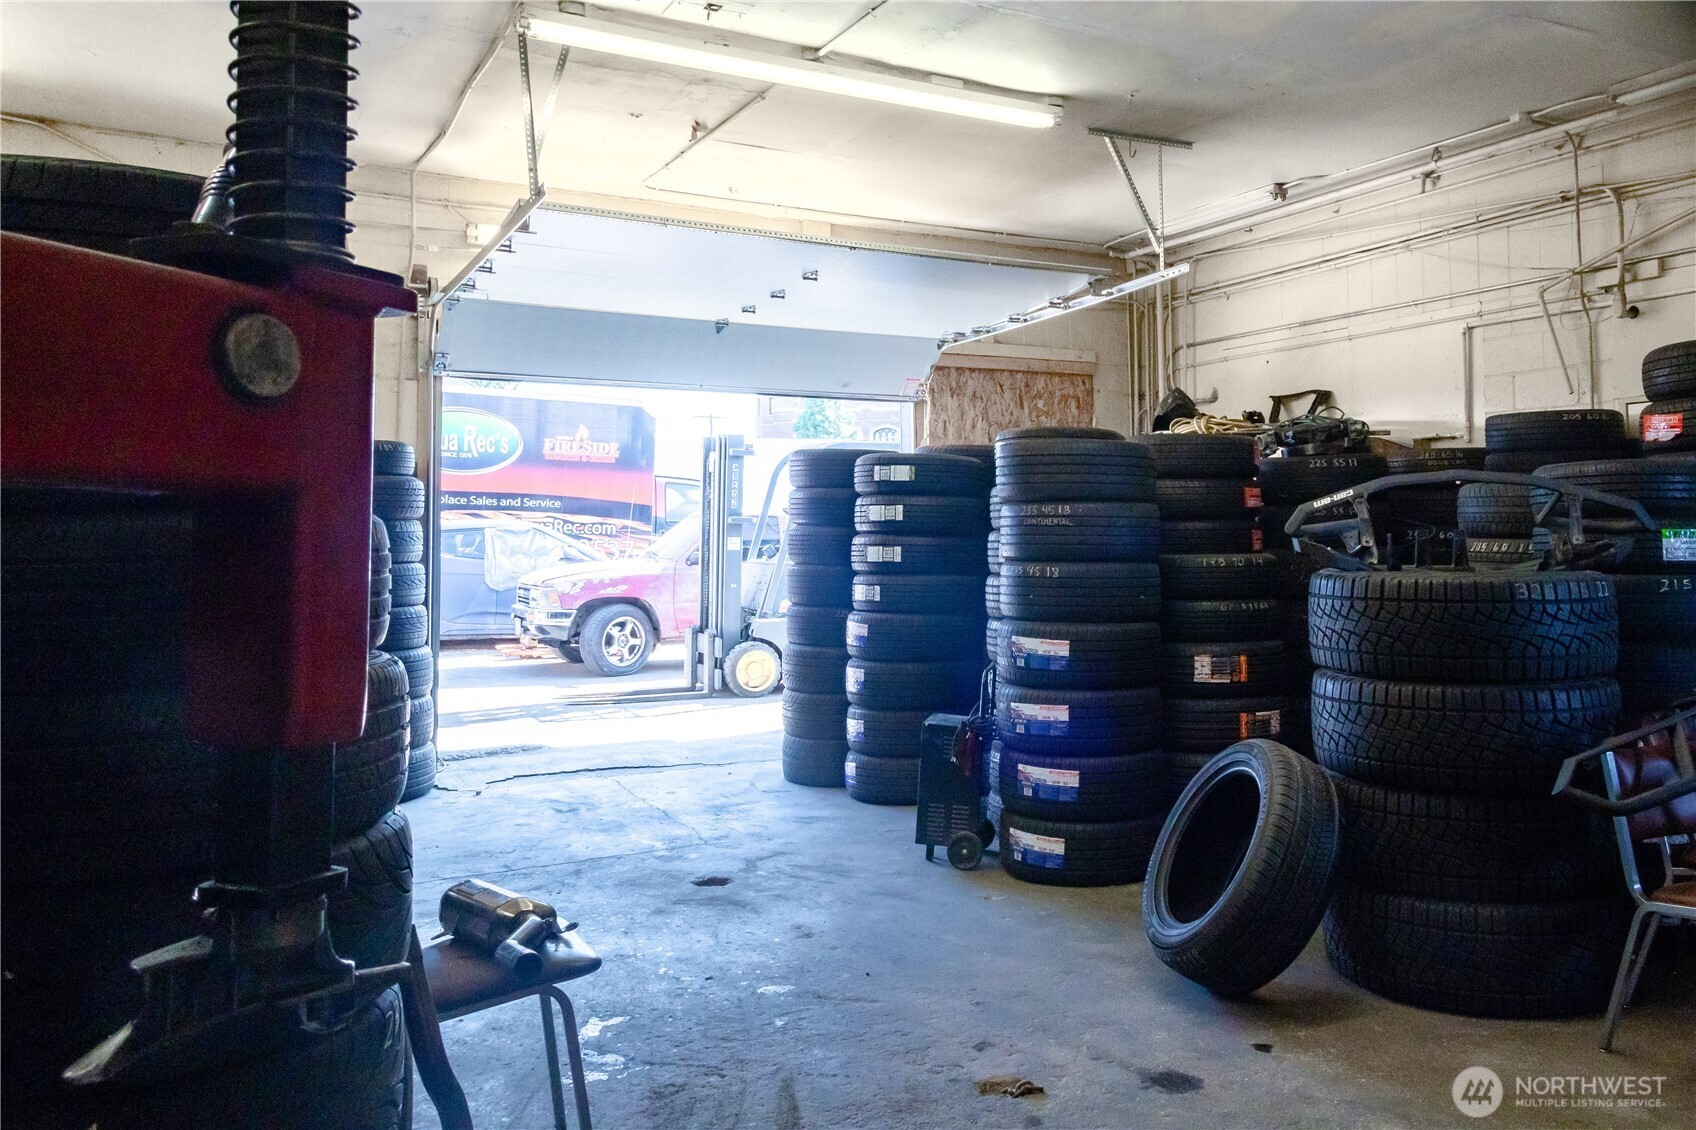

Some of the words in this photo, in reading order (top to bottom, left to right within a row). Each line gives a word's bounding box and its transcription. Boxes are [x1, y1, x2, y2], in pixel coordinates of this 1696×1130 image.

[463, 425, 510, 457] Rec's
[543, 438, 620, 455] FIRESIDE
[1309, 459, 1327, 467] 225
[731, 463, 739, 507] CLARK
[470, 496, 498, 506] Sales
[499, 497, 521, 507] and
[523, 498, 562, 508] Service
[1041, 505, 1054, 515] 45
[1026, 565, 1041, 576] 45
[1046, 566, 1060, 578] 18
[1660, 579, 1692, 592] 215
